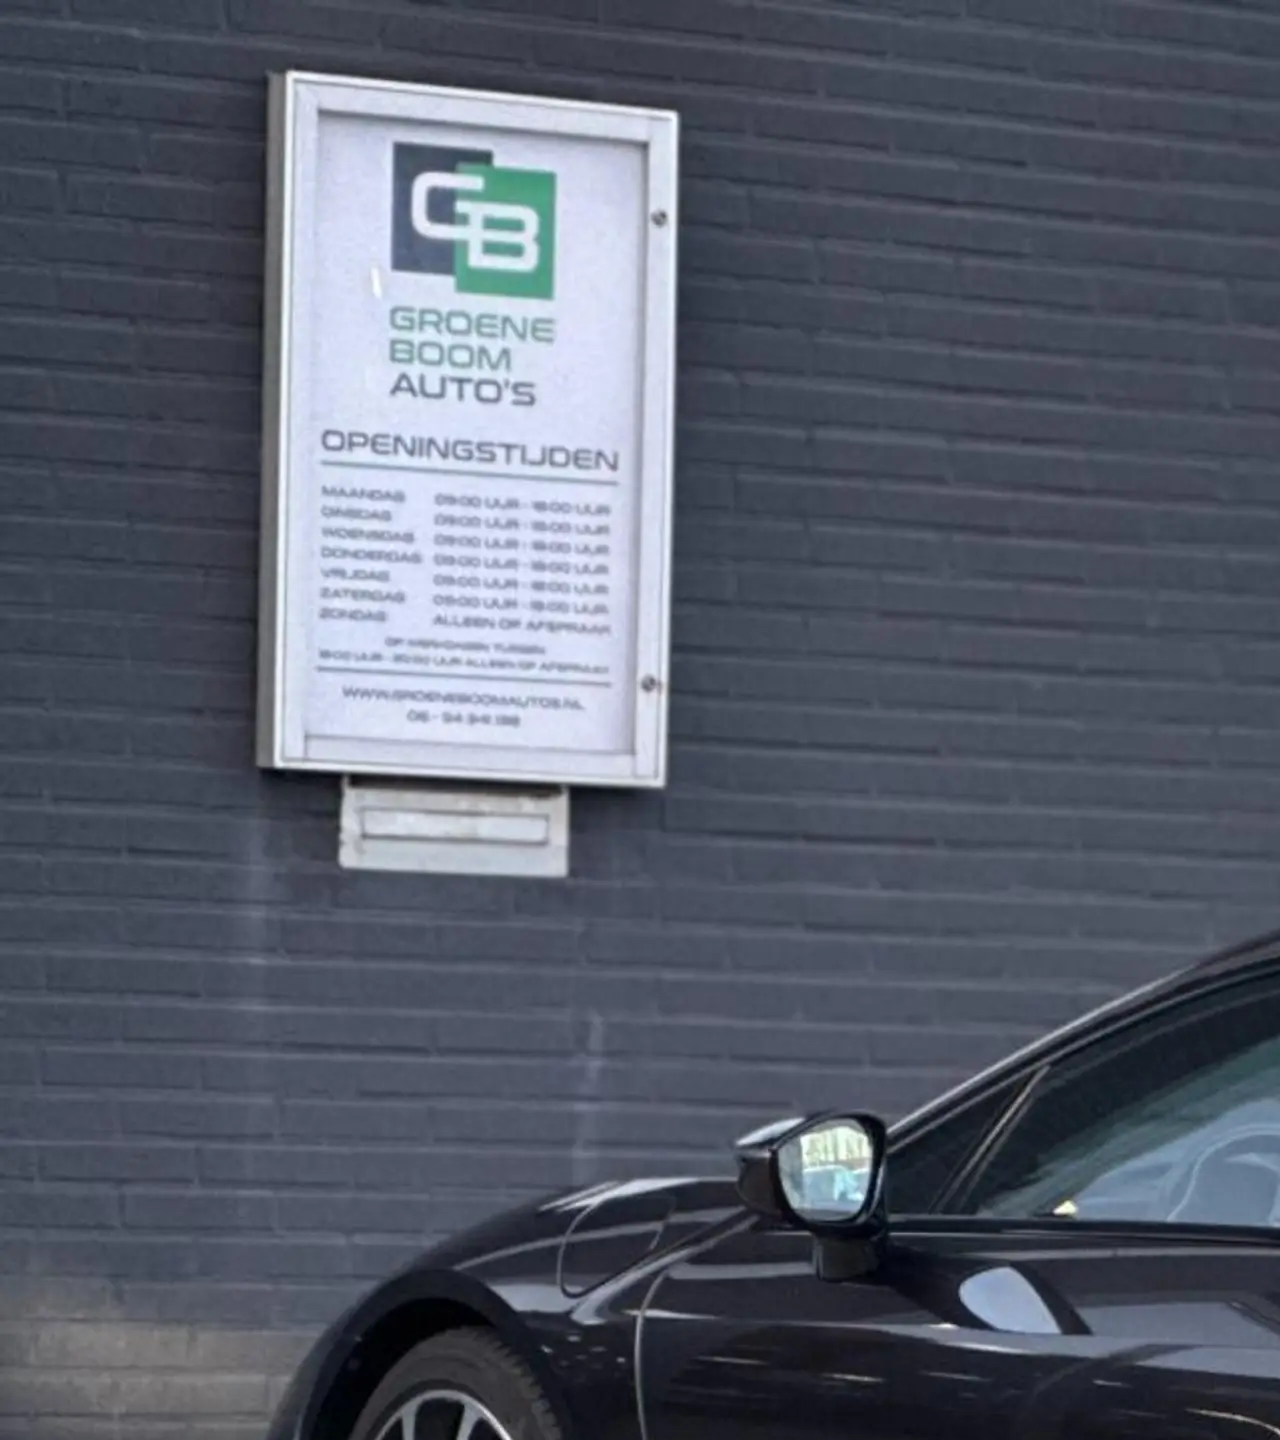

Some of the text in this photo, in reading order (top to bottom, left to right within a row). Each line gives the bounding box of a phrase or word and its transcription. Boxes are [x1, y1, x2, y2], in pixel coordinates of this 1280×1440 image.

[390, 306, 556, 344] GROENE
[389, 340, 512, 372] BOOM
[390, 373, 537, 407] AUTO'S
[321, 429, 619, 472] OPENINGSTIJDEN
